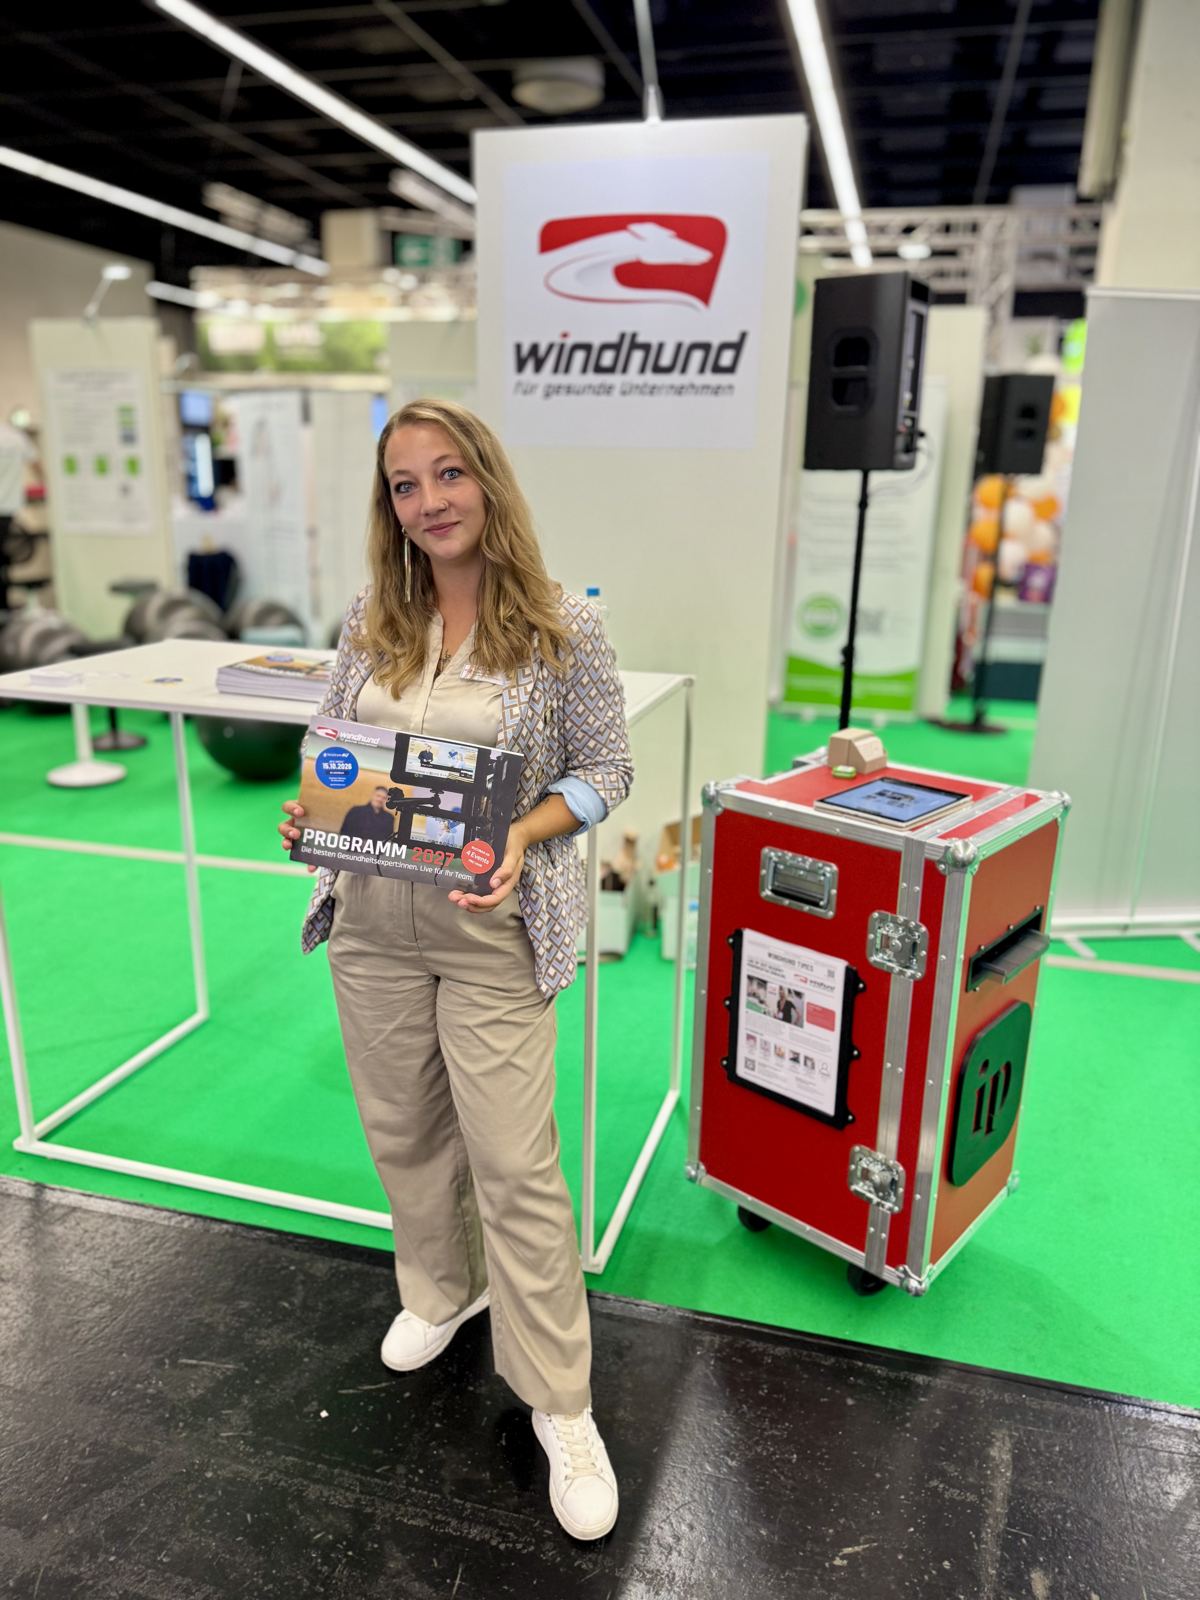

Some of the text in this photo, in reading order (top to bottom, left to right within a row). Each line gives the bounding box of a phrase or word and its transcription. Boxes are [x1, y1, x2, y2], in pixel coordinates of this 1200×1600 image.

[514, 331, 748, 374] windhund
[513, 381, 735, 399] für gesunde Unternehmen
[340, 732, 380, 744] windhund
[302, 828, 407, 859] PROGRAMM
[411, 846, 455, 868] 2027
[470, 852, 490, 864] Events
[313, 848, 336, 857] besten
[420, 865, 433, 873] Live
[434, 867, 443, 875] für
